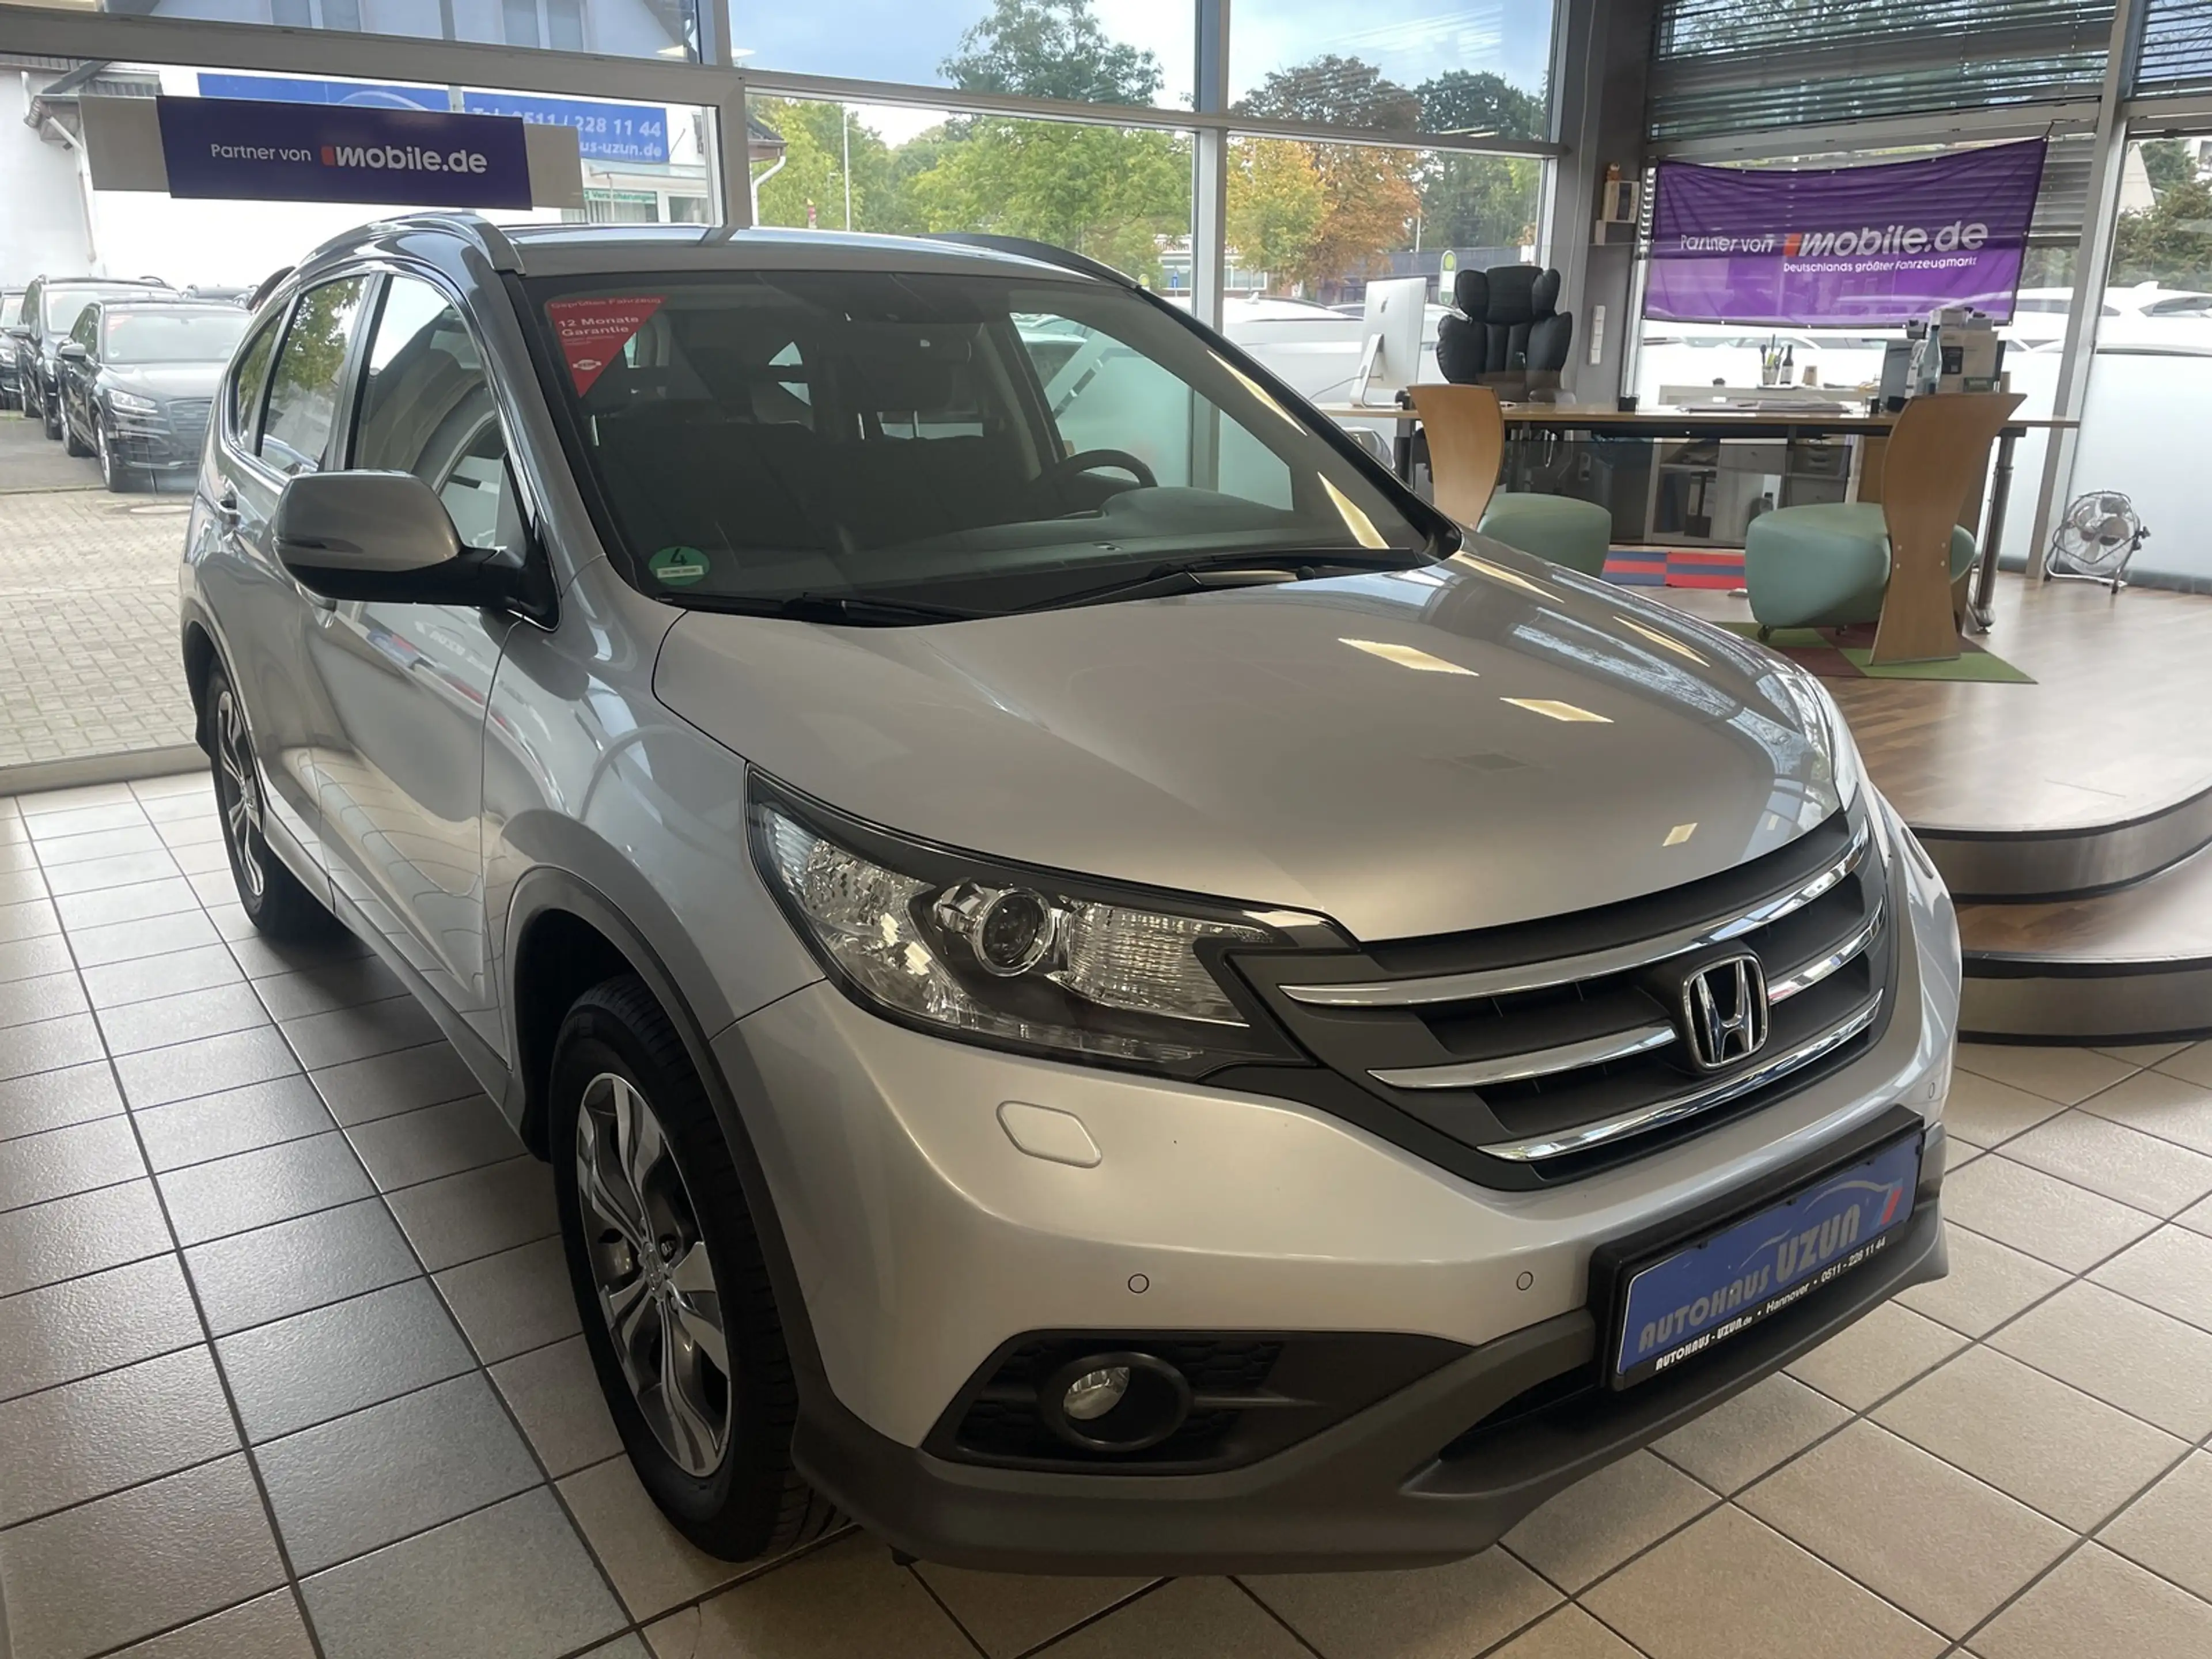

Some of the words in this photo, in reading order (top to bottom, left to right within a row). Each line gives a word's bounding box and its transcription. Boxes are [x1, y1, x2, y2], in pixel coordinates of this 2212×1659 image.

[575, 116, 607, 132] 228
[614, 120, 632, 135] 11
[639, 122, 661, 137] 44
[211, 143, 275, 160] Partner
[279, 148, 312, 161] von
[335, 146, 487, 173] mobile.de
[1680, 234, 1736, 252] Partner
[1741, 236, 1775, 253] von
[1798, 221, 1988, 257] mobile.de
[1783, 262, 1853, 272] Deutschlands
[1855, 260, 1894, 273] größter
[1895, 256, 1978, 271] Fahrzeugmarkt
[558, 319, 577, 328] 12
[581, 316, 639, 326] Monate
[562, 325, 629, 337] Garantie
[670, 547, 688, 566] 4
[1638, 1264, 1771, 1353] AUTOHAUS
[1775, 1203, 1860, 1284] UZUN
[1766, 1282, 1810, 1314] Hannover
[1821, 1263, 1841, 1283] 0511
[1865, 1243, 1874, 1256] 11
[1876, 1236, 1886, 1249] 44
